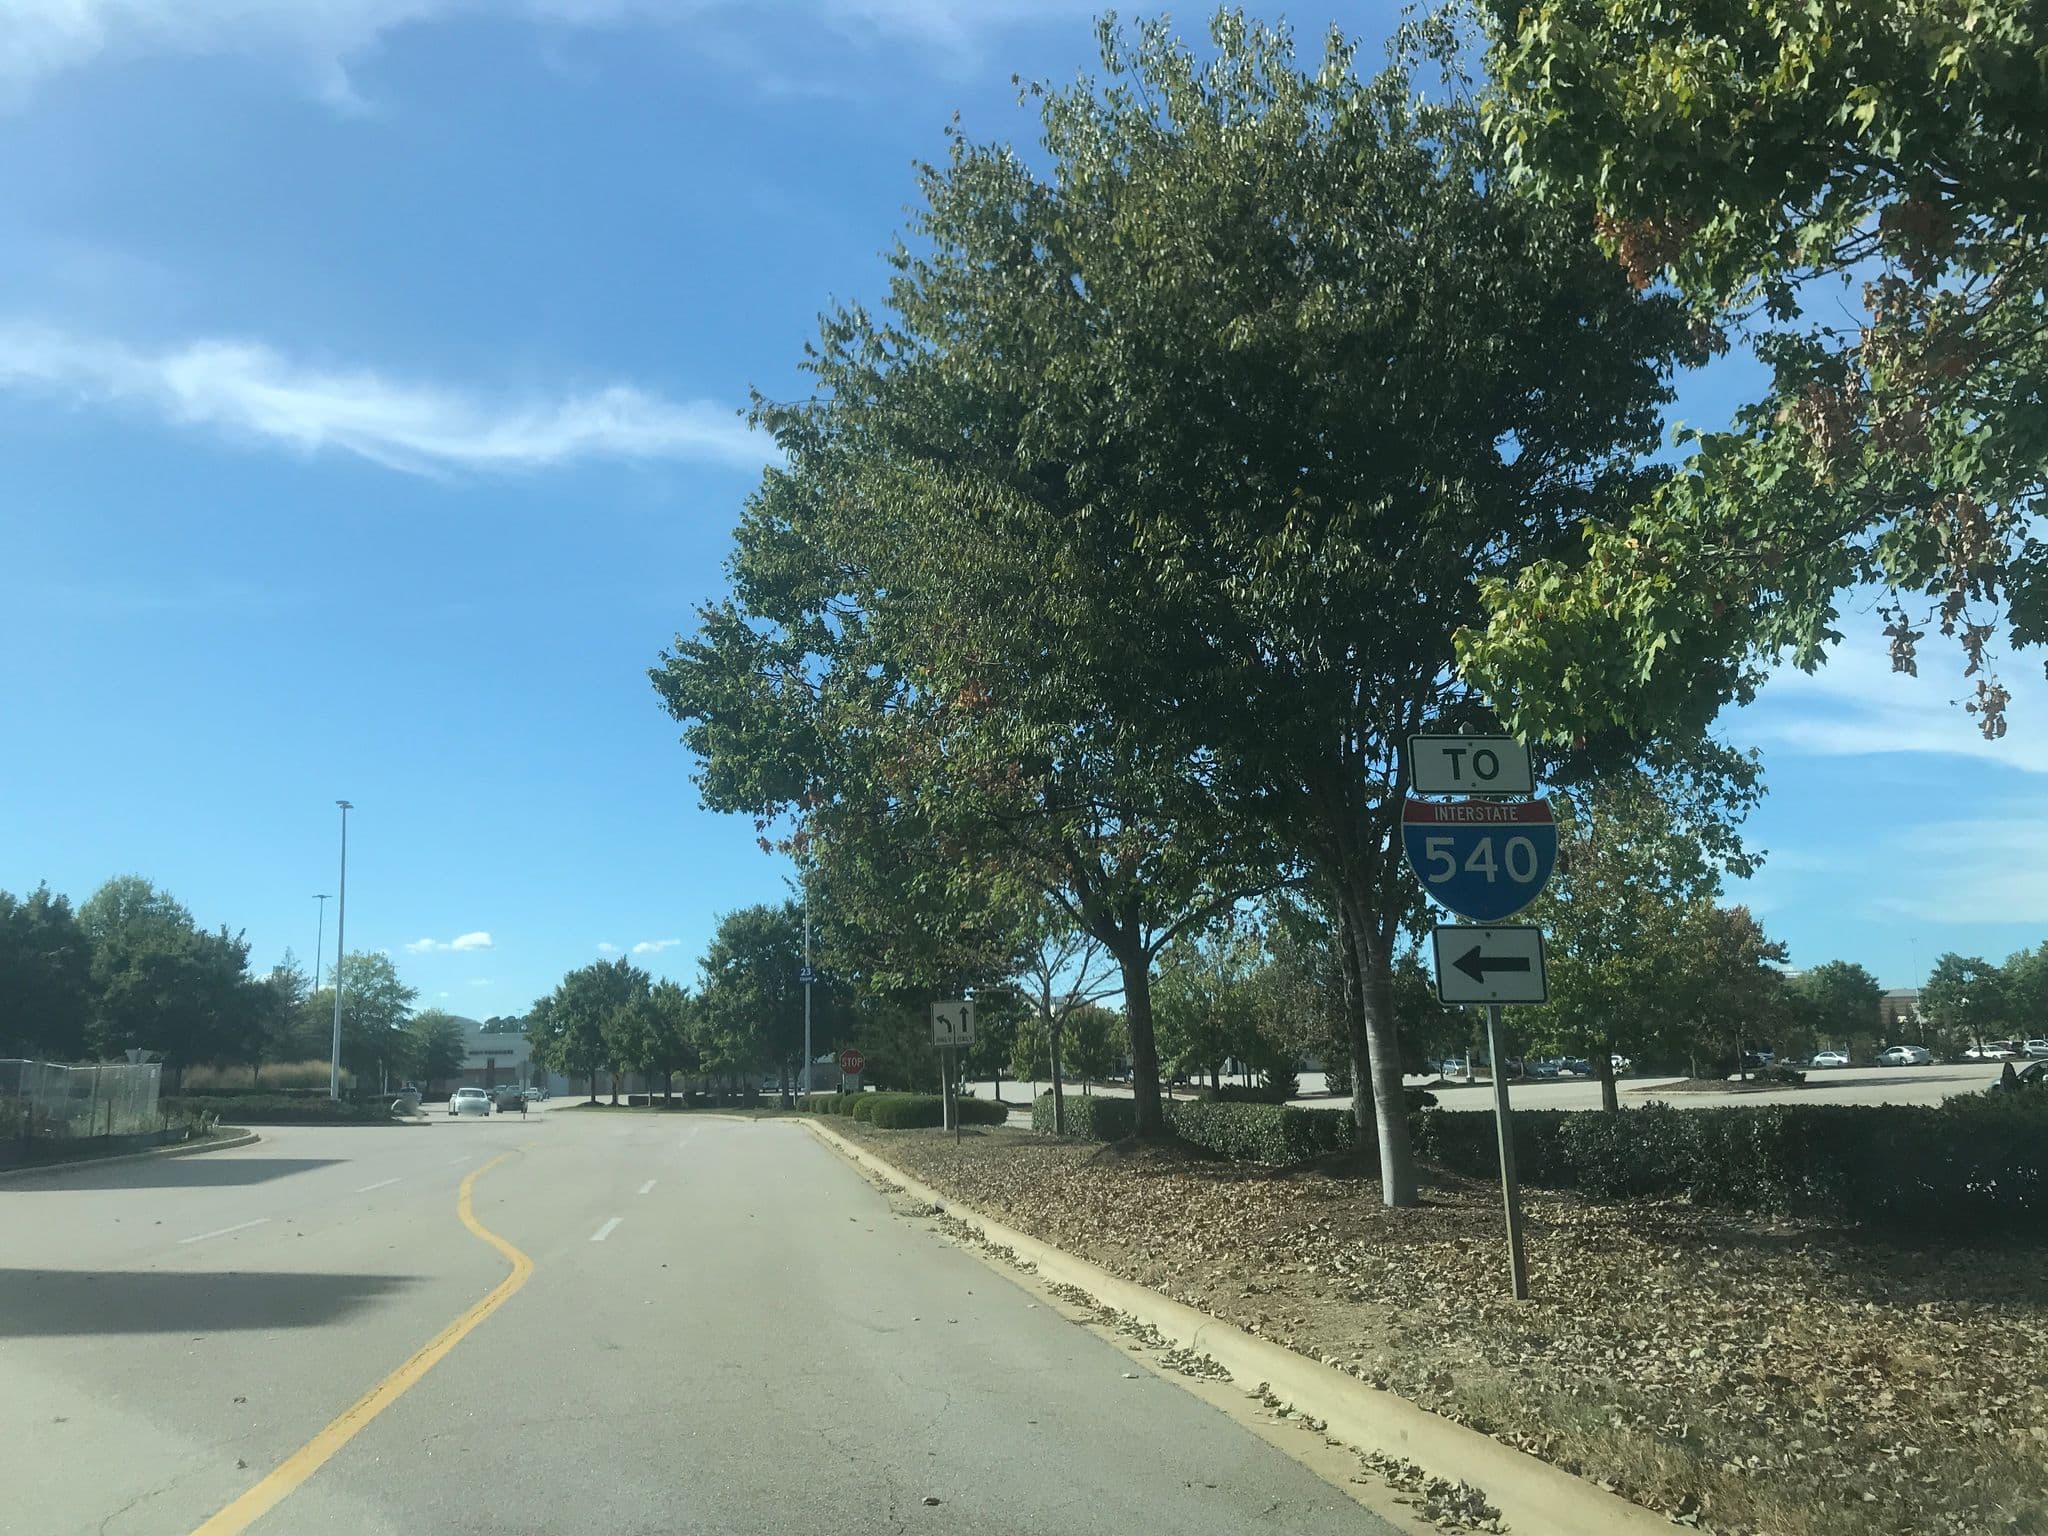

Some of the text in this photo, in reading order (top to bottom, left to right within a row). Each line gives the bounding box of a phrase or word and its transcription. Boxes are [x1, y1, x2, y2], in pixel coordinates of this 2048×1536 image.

[1443, 748, 1500, 781] TO
[1434, 805, 1519, 822] INTERSTATE
[1425, 836, 1539, 883] 540
[800, 967, 811, 976] 23
[841, 1057, 864, 1068] STOP
